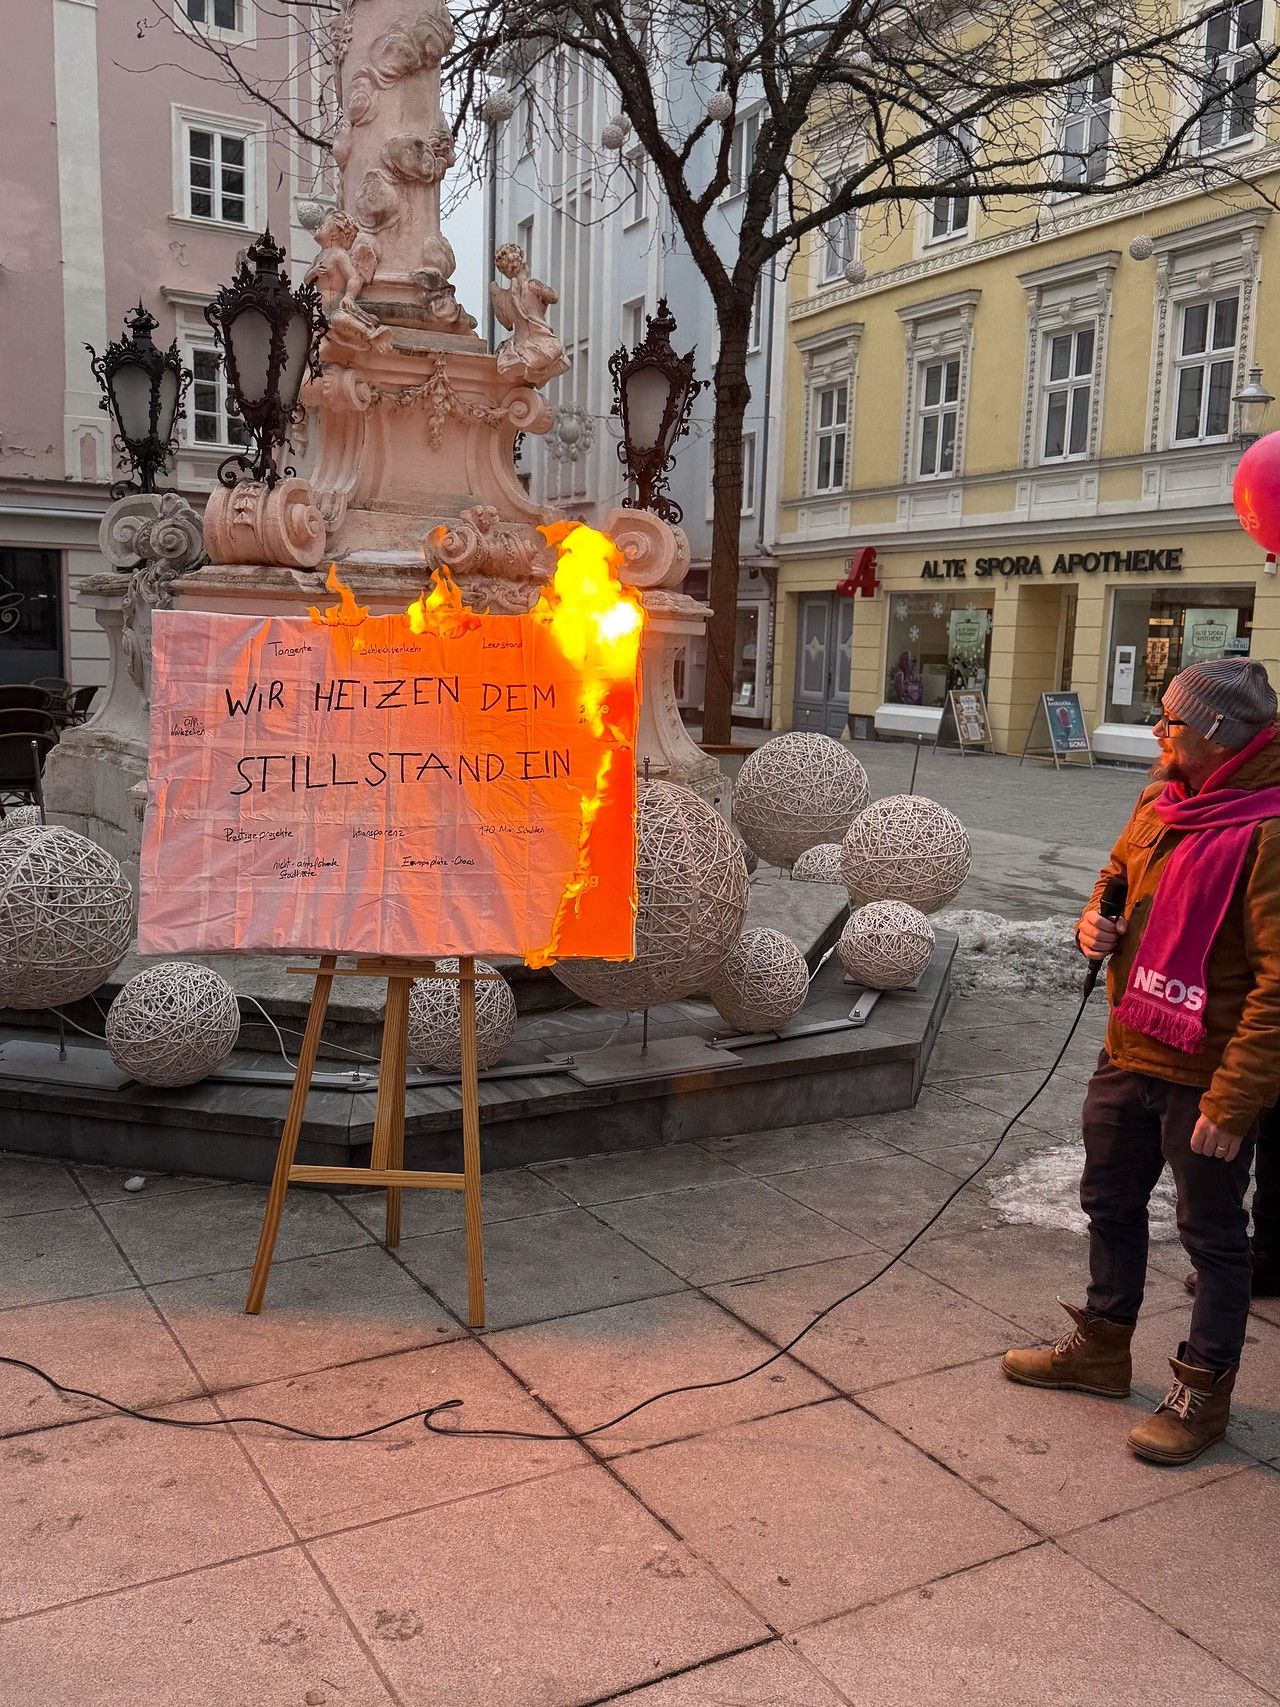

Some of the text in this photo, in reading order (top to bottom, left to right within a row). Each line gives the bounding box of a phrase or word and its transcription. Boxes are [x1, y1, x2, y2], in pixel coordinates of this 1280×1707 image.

[921, 548, 1184, 579] ALTE SPORA APOTHEKE
[268, 641, 313, 657] Tangente
[482, 637, 523, 650] Leerstand
[225, 680, 284, 717] WIR
[315, 675, 460, 712] HEIZEN
[481, 683, 556, 713] DEM
[230, 749, 570, 796] STILLSTAND EIN
[478, 825, 496, 836] 170
[1133, 965, 1206, 1012] NEOS
